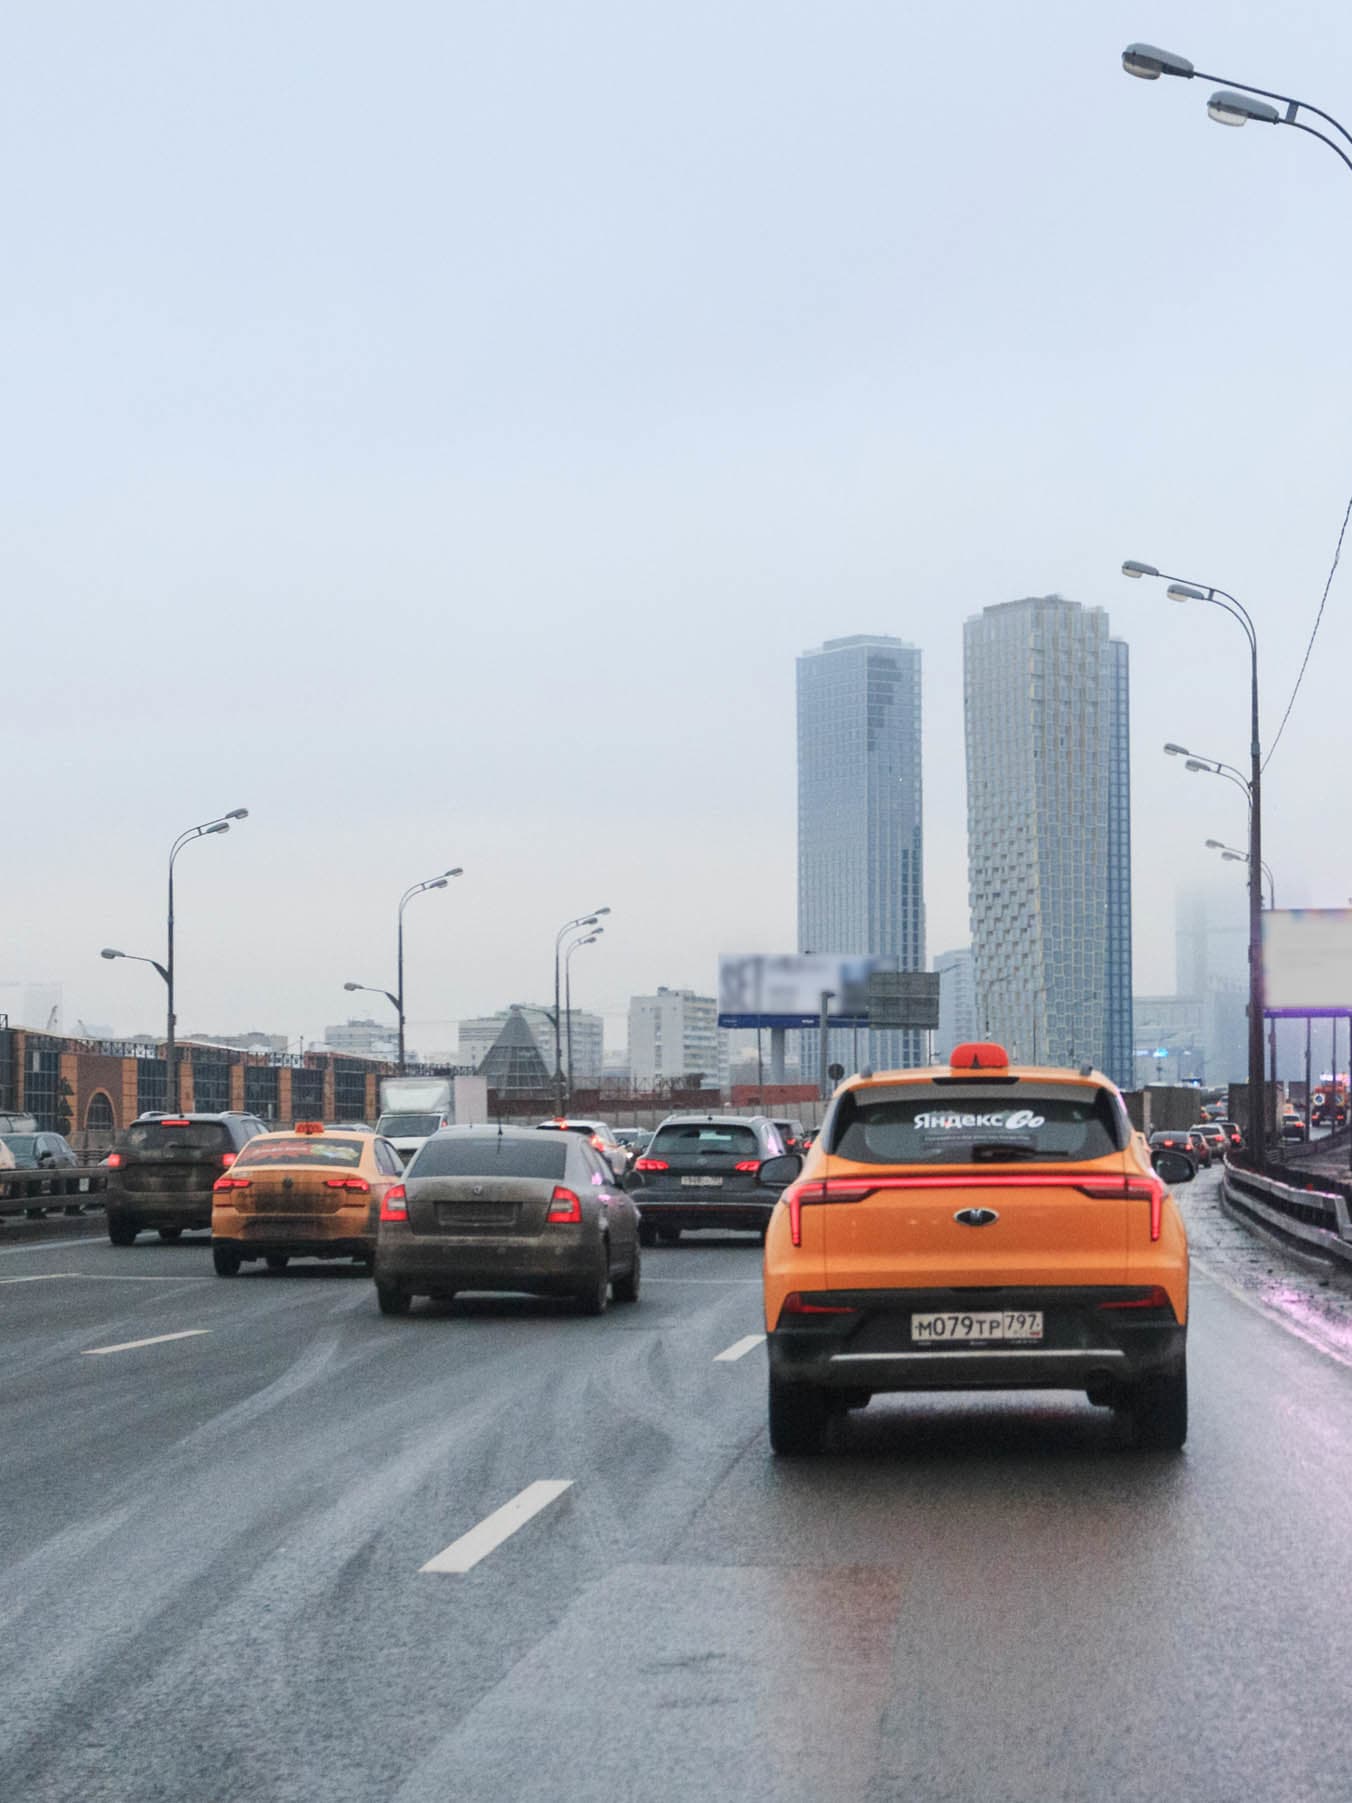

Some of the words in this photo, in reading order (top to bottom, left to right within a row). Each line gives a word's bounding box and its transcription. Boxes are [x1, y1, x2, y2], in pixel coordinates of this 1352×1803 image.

[914, 1113, 1003, 1129] Яндекс
[1005, 1110, 1045, 1129] Go
[918, 1315, 1000, 1336] М079ТР
[1006, 1314, 1036, 1331] 797
